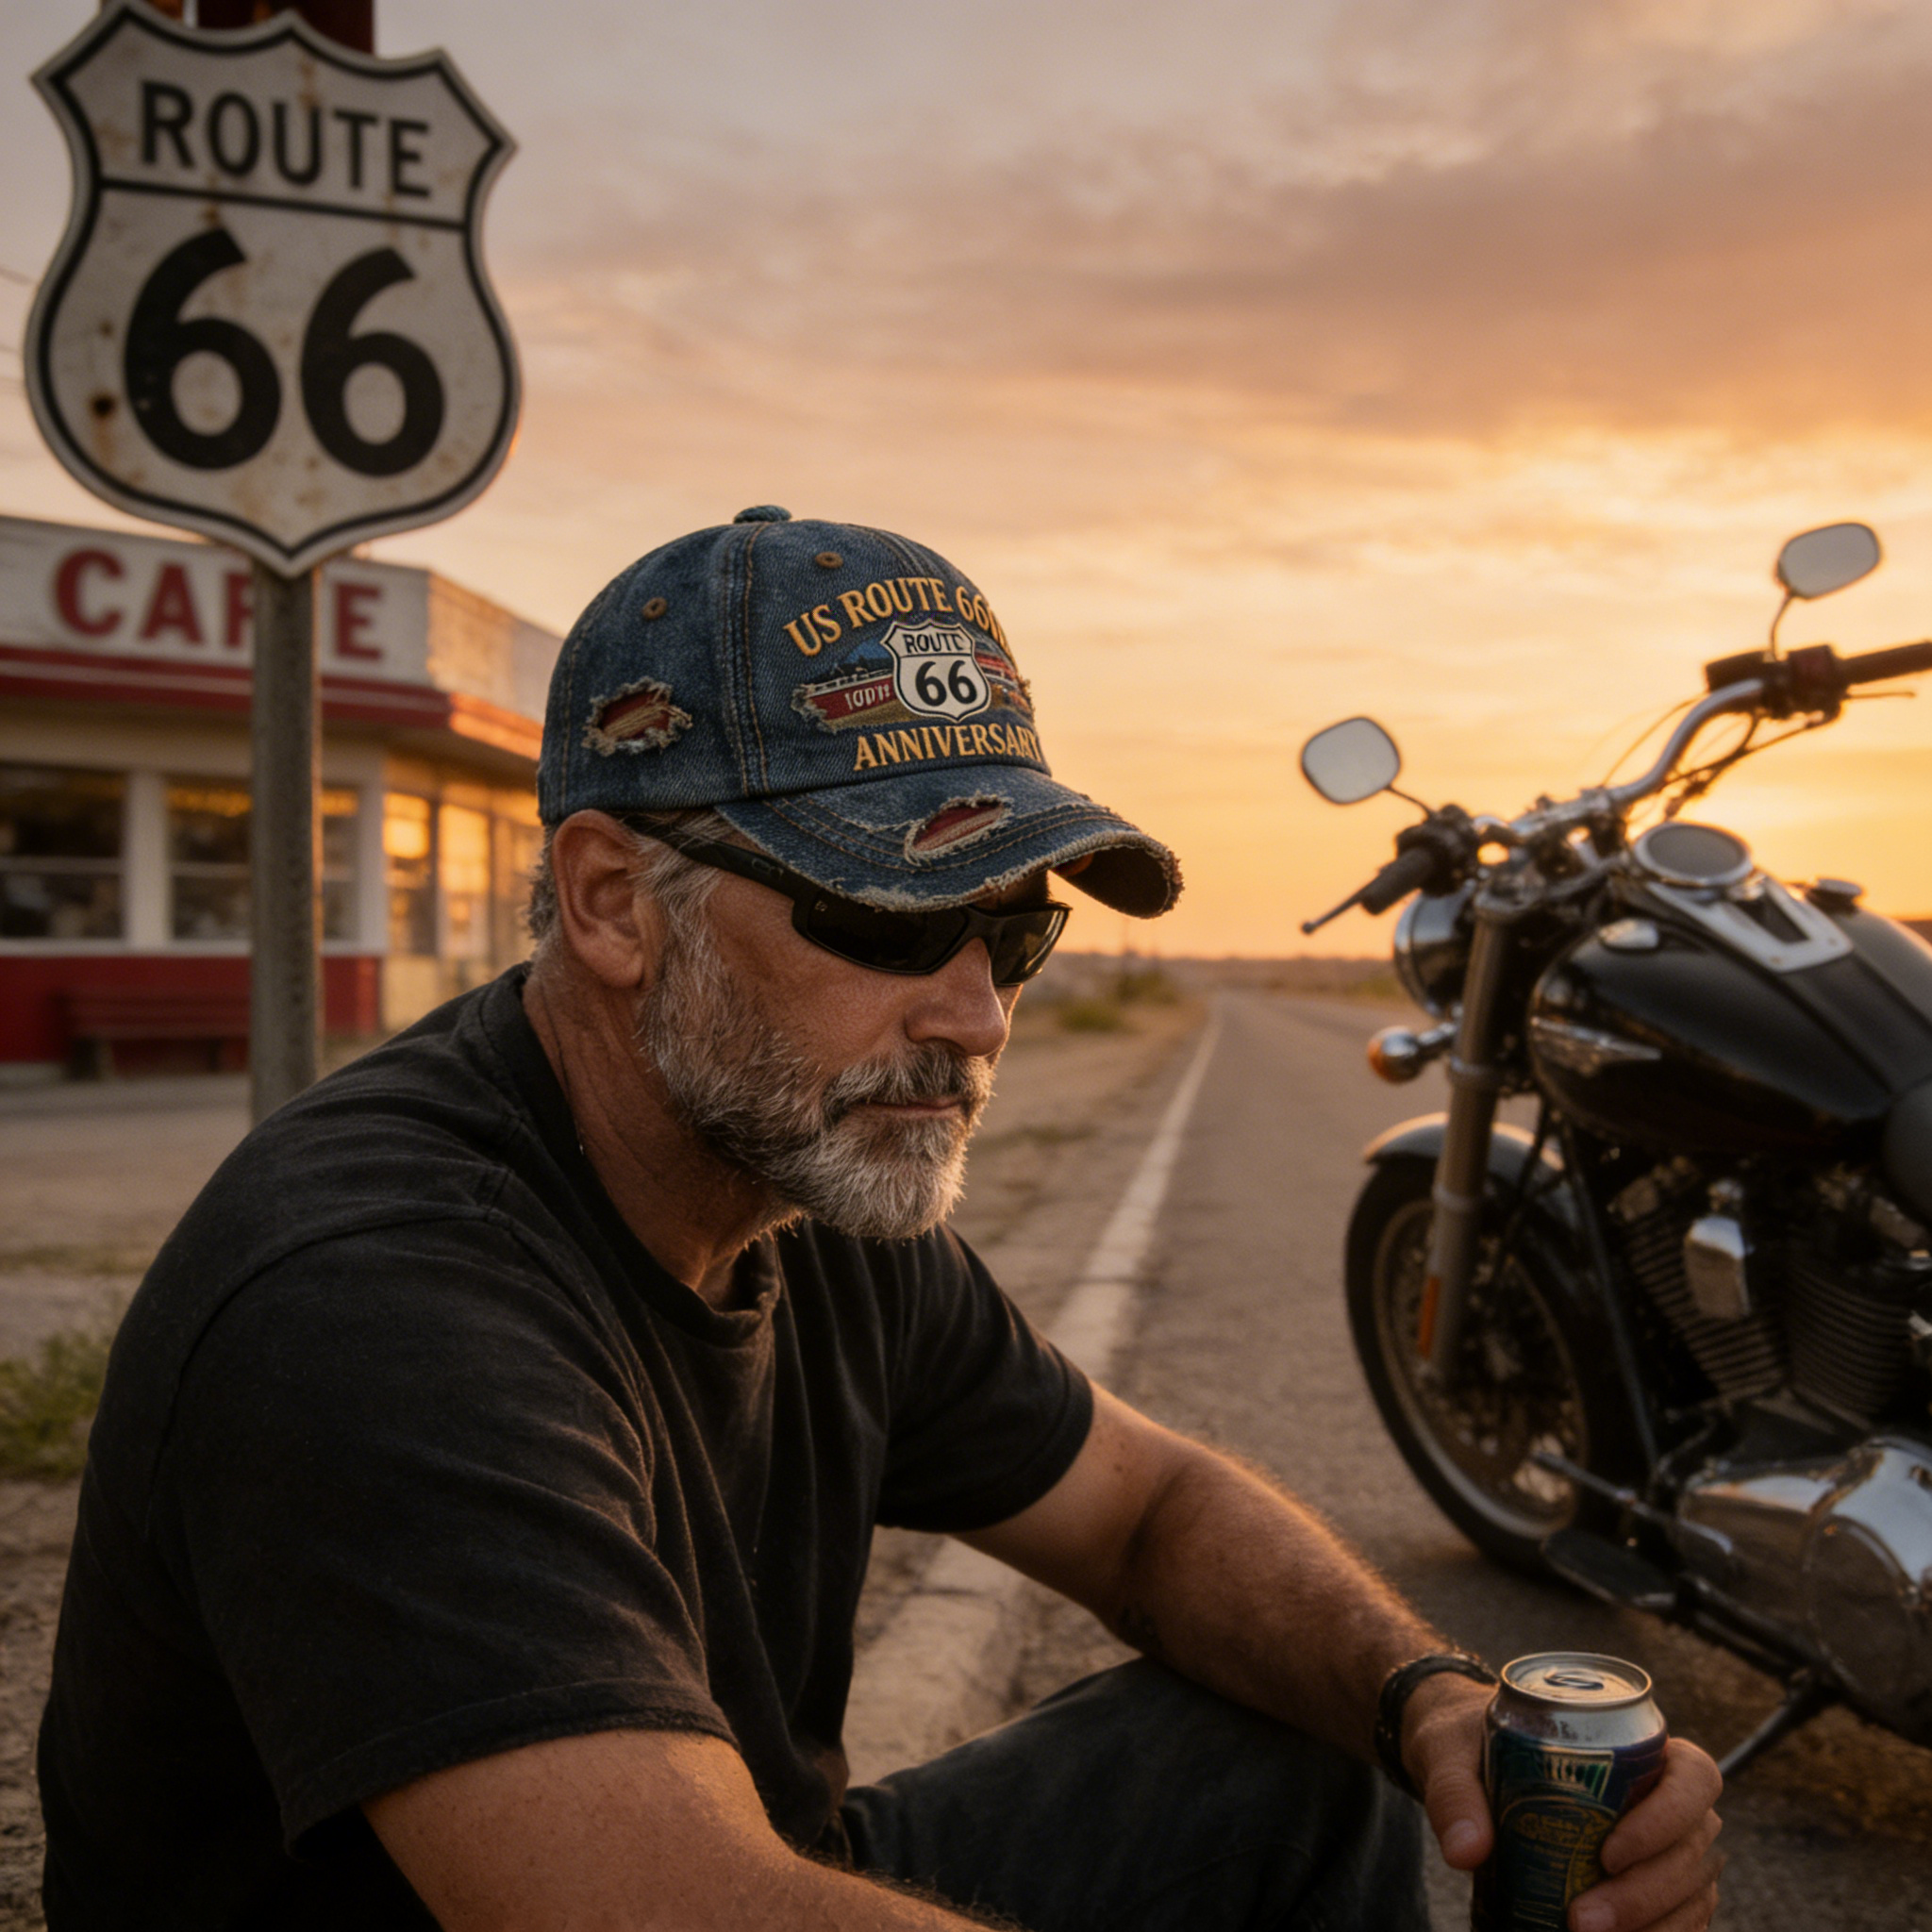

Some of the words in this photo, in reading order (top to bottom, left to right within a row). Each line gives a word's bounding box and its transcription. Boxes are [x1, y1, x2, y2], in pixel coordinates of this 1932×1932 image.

[139, 79, 431, 200] ROUTE
[124, 226, 446, 479] 66
[783, 605, 842, 657] US
[837, 577, 953, 629] ROUTE
[915, 659, 978, 708] 66
